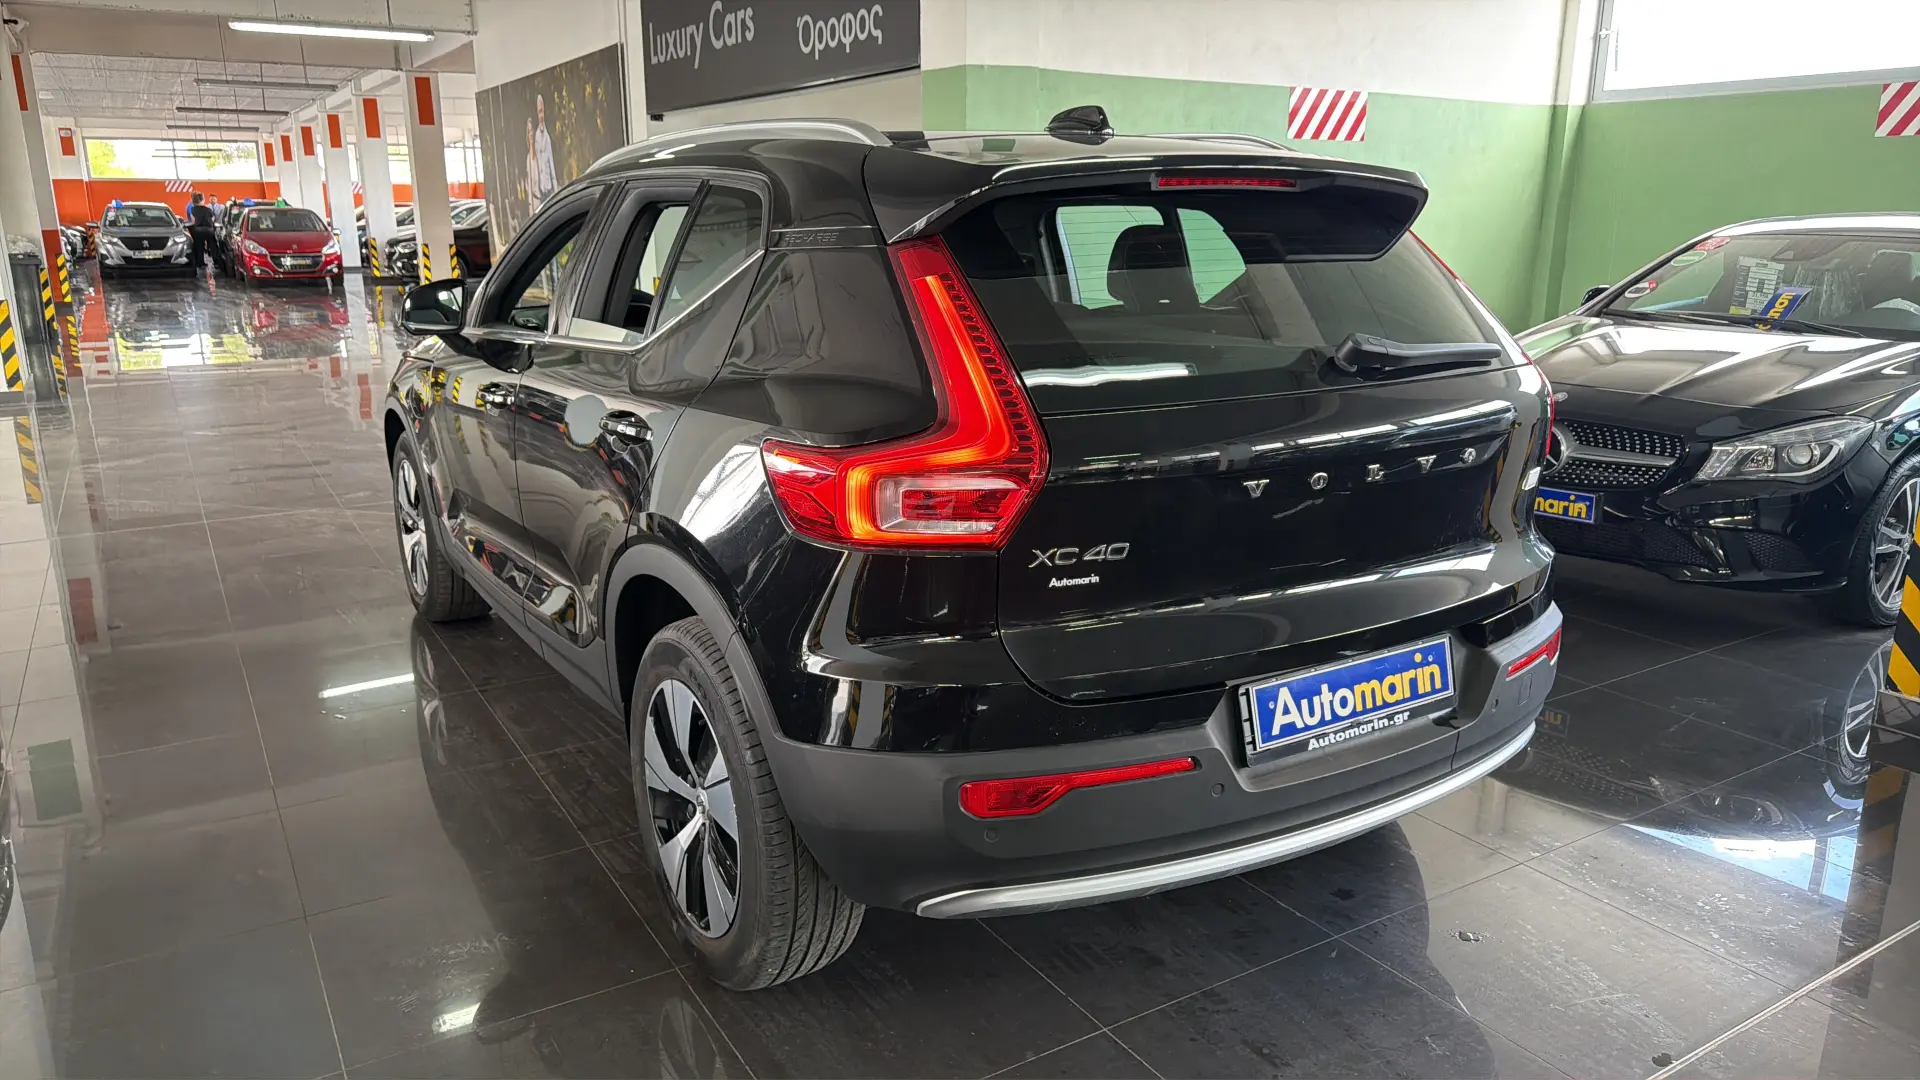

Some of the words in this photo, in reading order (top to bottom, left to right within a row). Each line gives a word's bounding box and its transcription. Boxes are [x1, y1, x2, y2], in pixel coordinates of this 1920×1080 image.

[650, 22, 703, 69] Luxury
[709, 0, 755, 49] Cars
[796, 4, 883, 60] Όροφος
[1243, 447, 1476, 498] VOLVO
[1049, 573, 1099, 588] Automarin
[1271, 653, 1441, 736] Automarin
[1307, 710, 1410, 751] Automarin.gr
